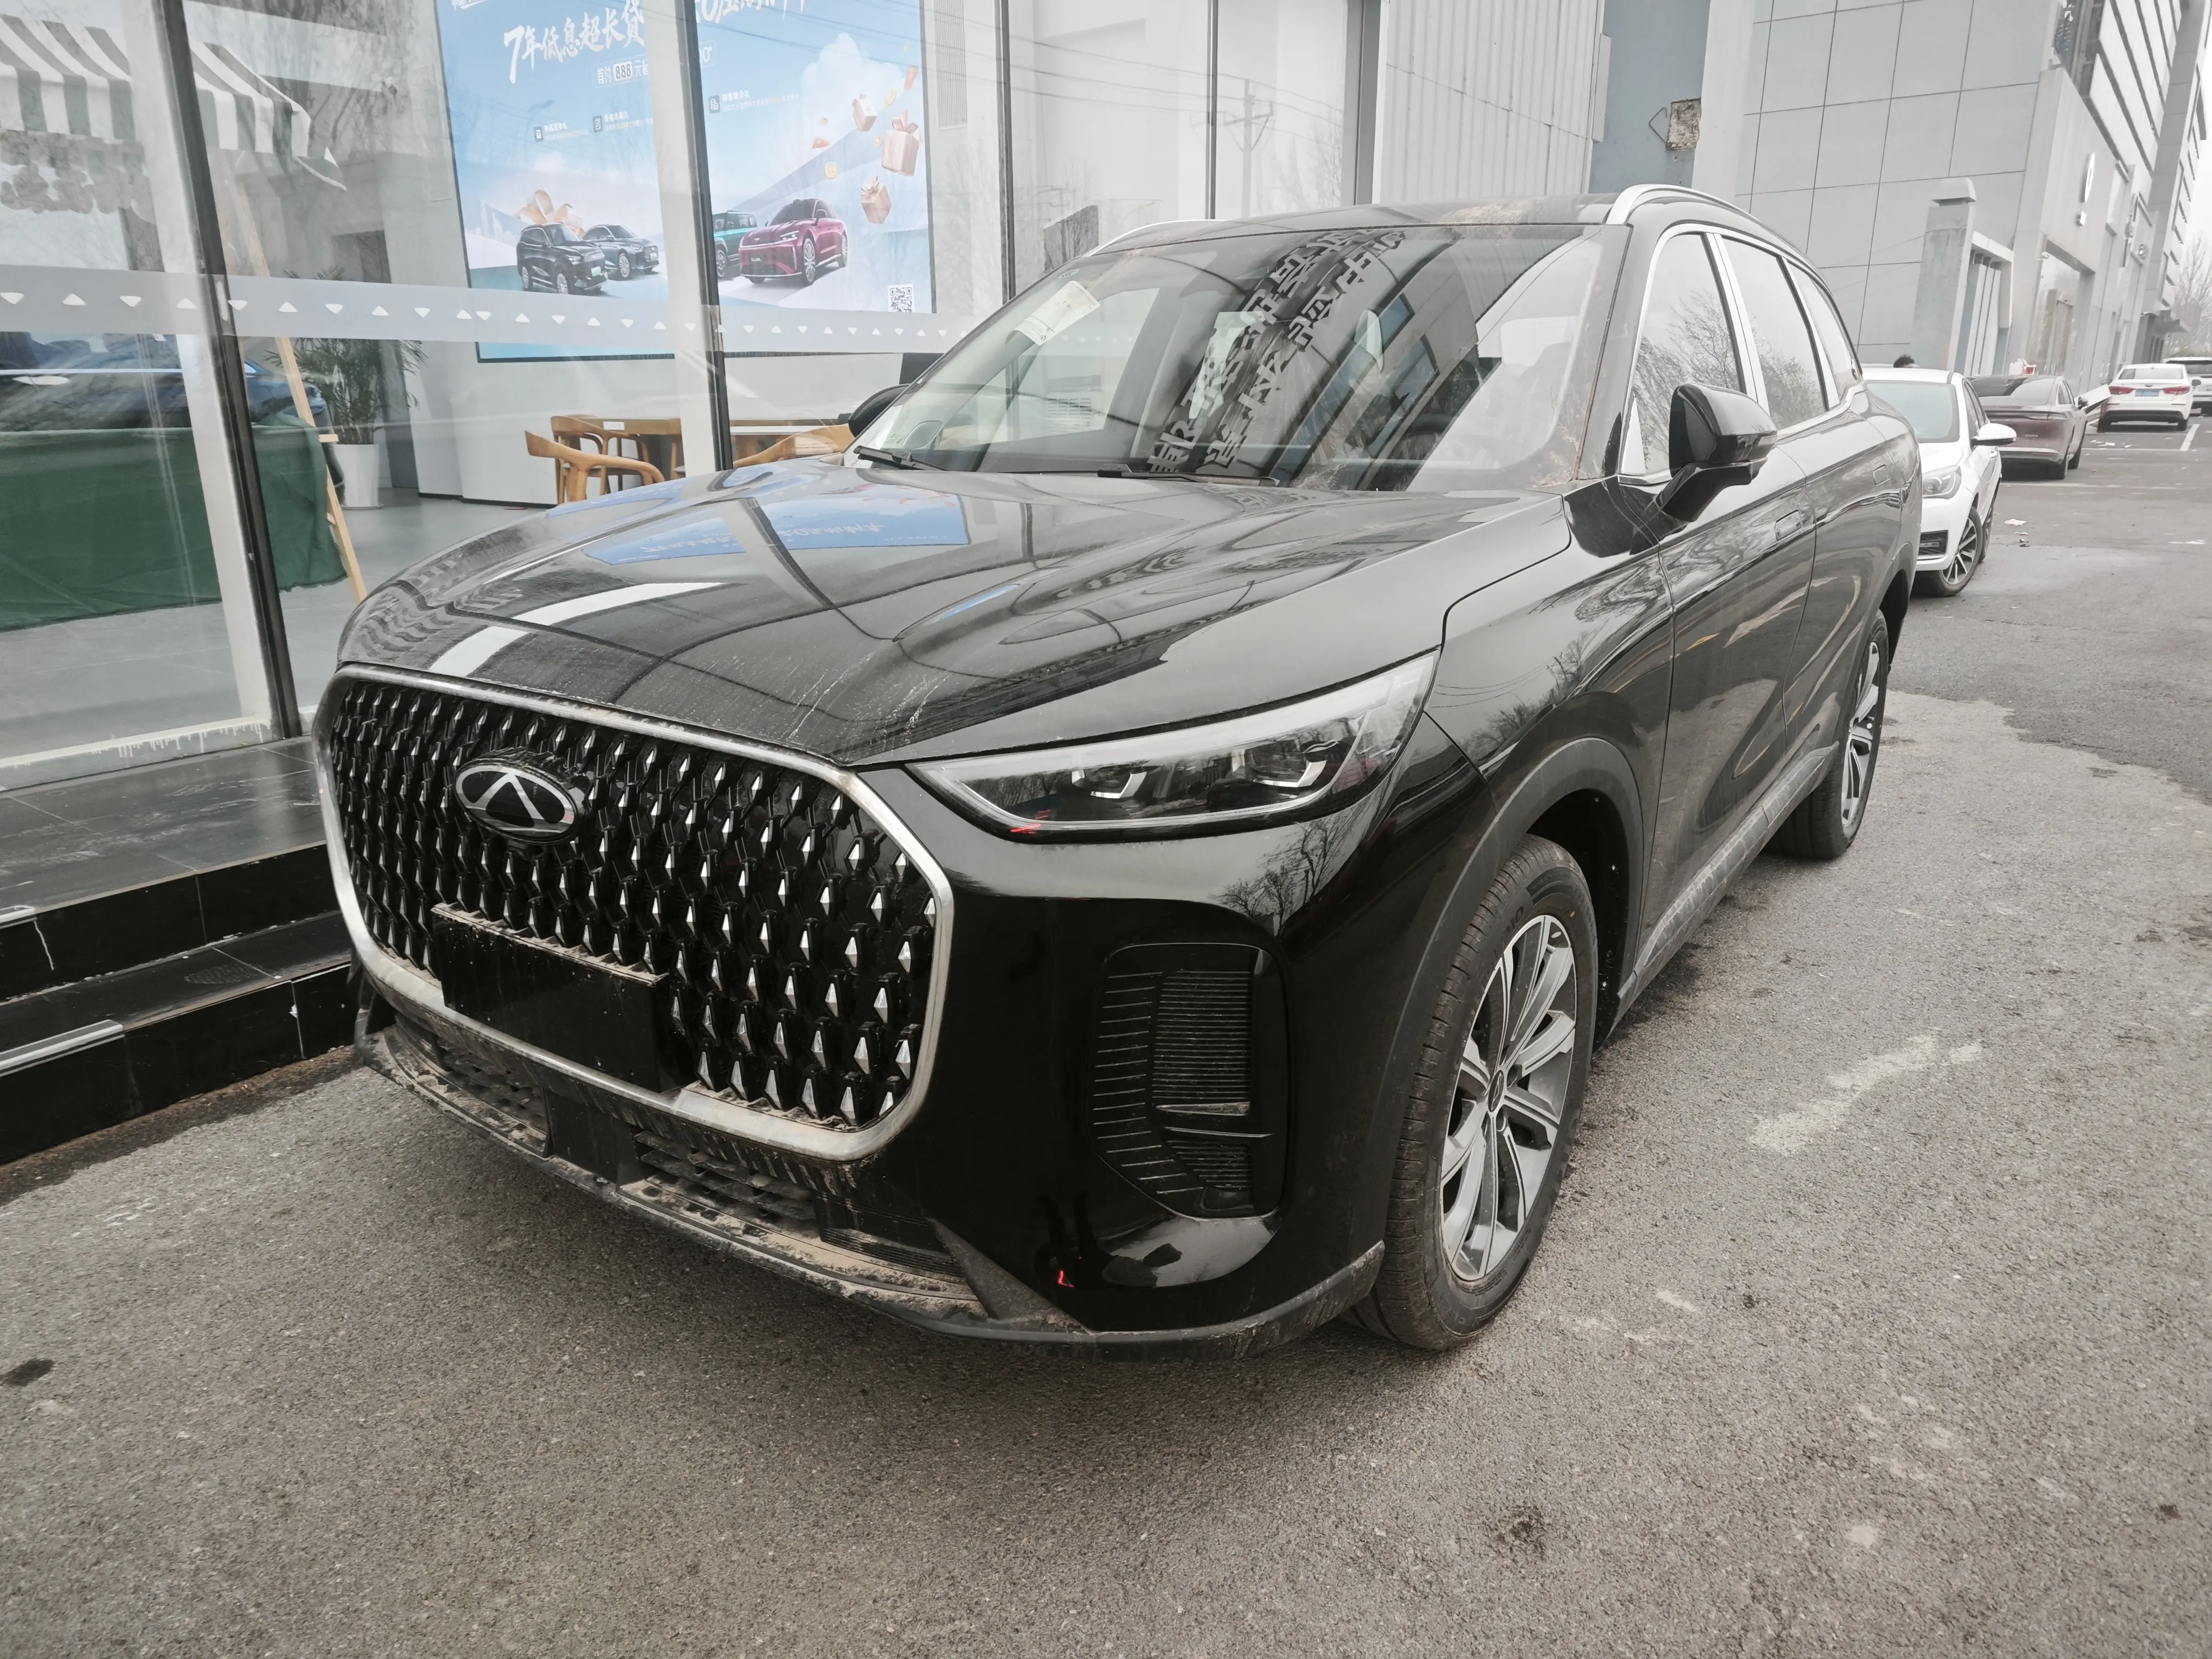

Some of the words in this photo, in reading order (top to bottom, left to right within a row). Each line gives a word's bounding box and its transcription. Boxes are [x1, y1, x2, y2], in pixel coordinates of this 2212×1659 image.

[504, 0, 645, 84] 7年低息超长贷
